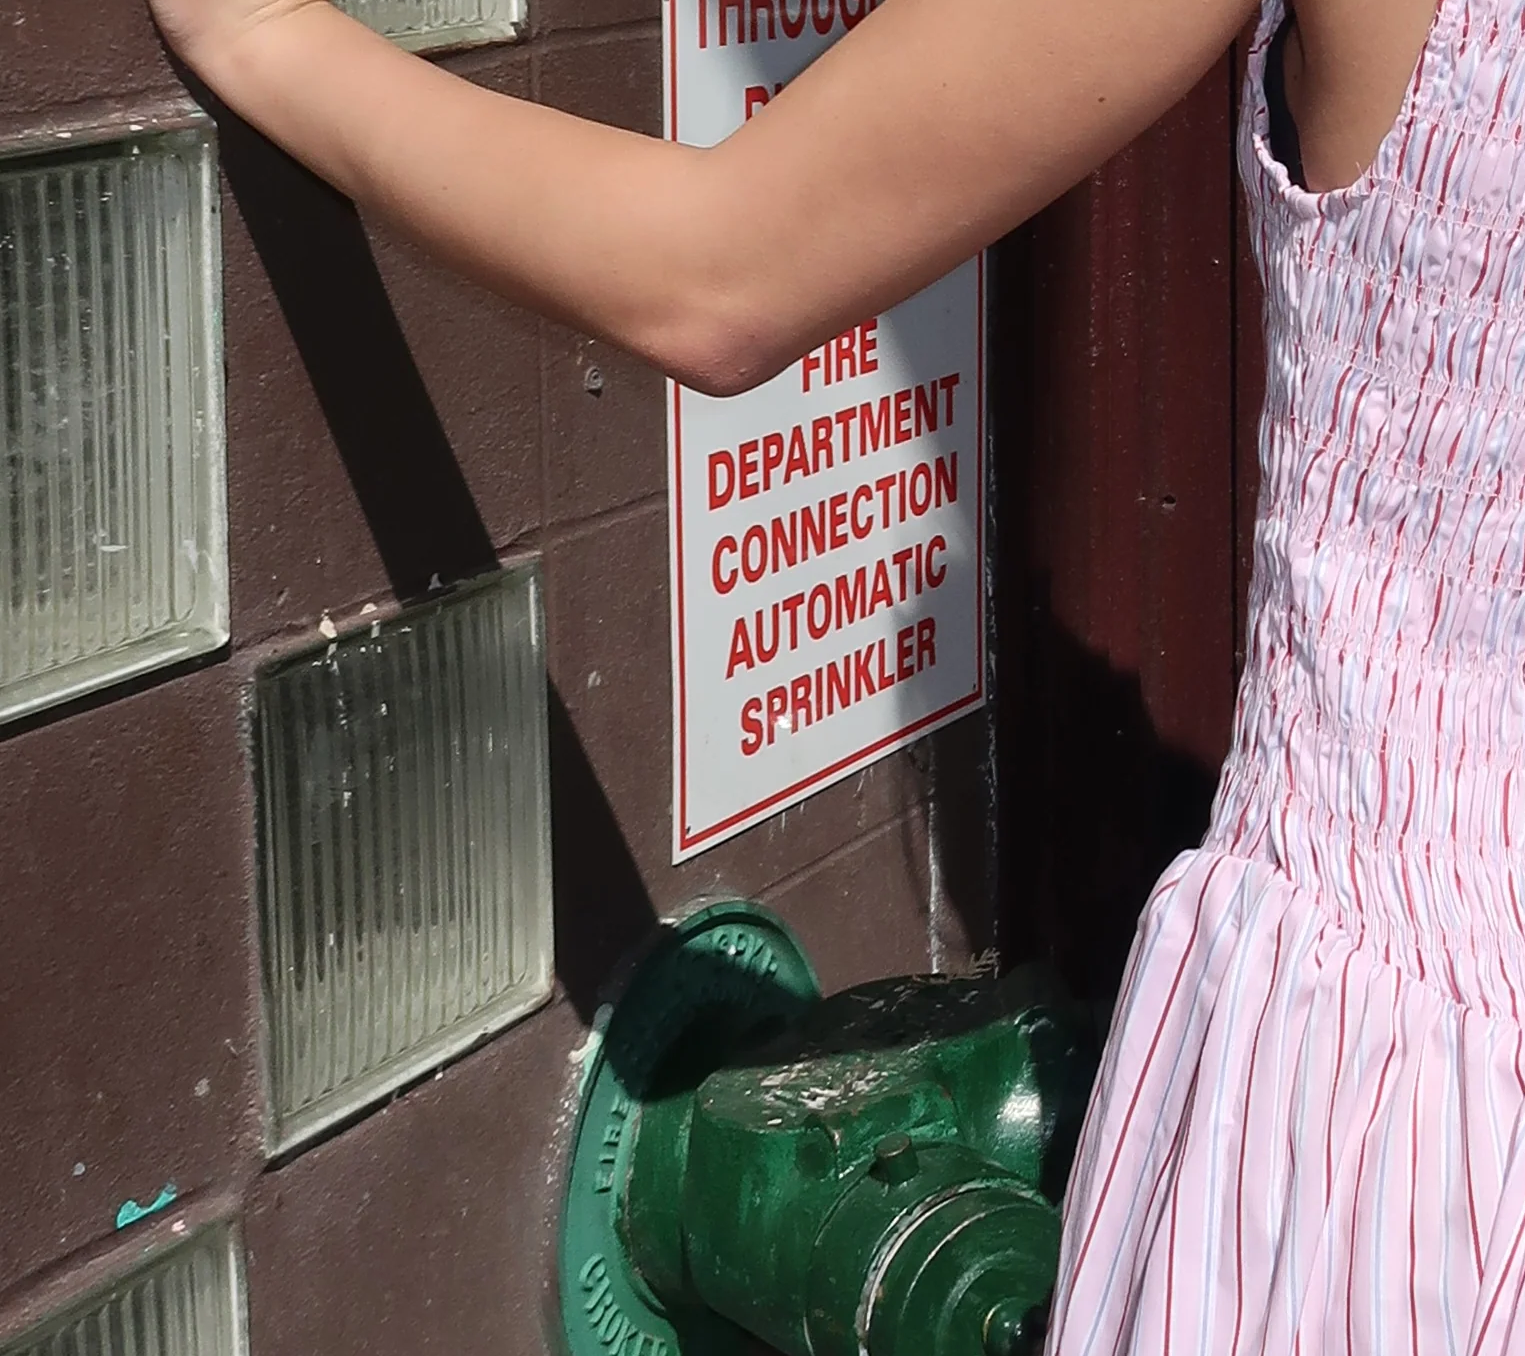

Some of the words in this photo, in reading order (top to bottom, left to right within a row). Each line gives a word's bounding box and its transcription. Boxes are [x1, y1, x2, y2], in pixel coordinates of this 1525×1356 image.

[803, 317, 878, 393] FIRE
[708, 372, 960, 511] DEPARTMENT
[712, 451, 958, 595] CONNECTION
[725, 535, 947, 680] AUTOMATIC
[741, 617, 936, 757] SPRINKLER
